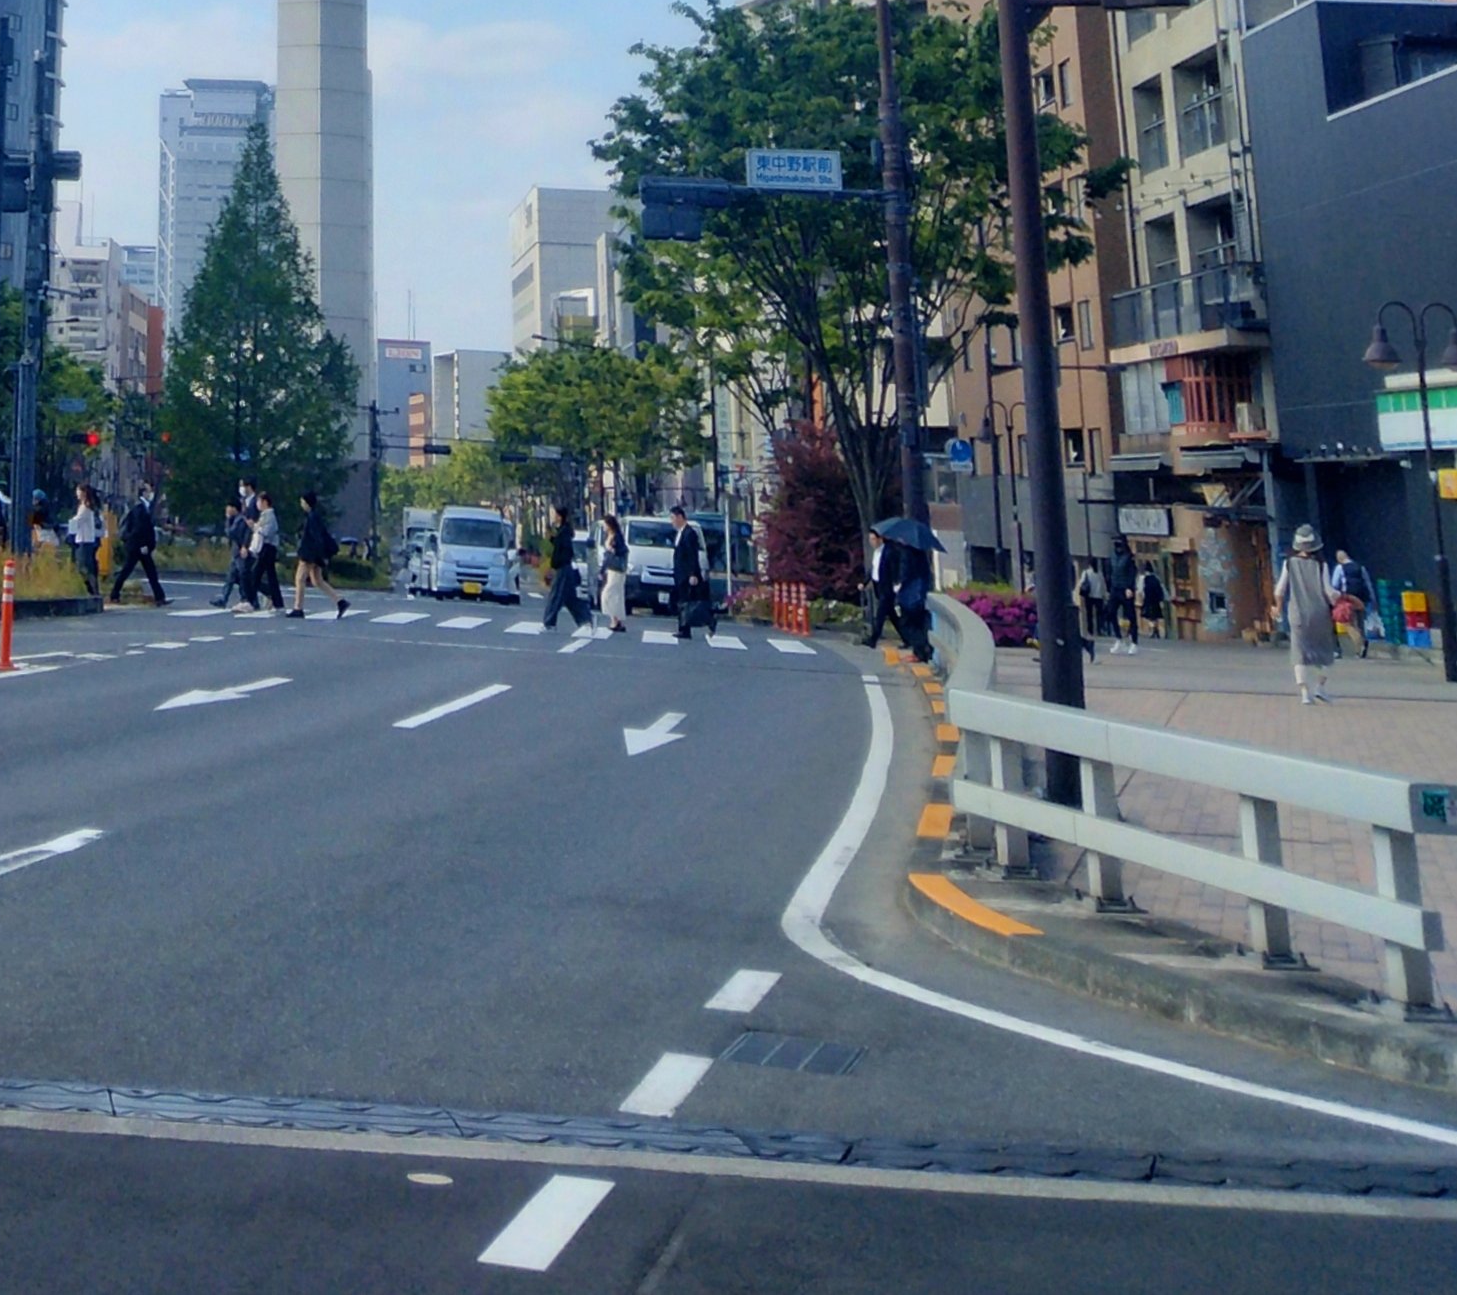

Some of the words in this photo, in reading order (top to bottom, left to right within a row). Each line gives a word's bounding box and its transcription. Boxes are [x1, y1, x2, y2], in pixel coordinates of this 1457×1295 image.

[756, 154, 833, 173] 東中野駅前
